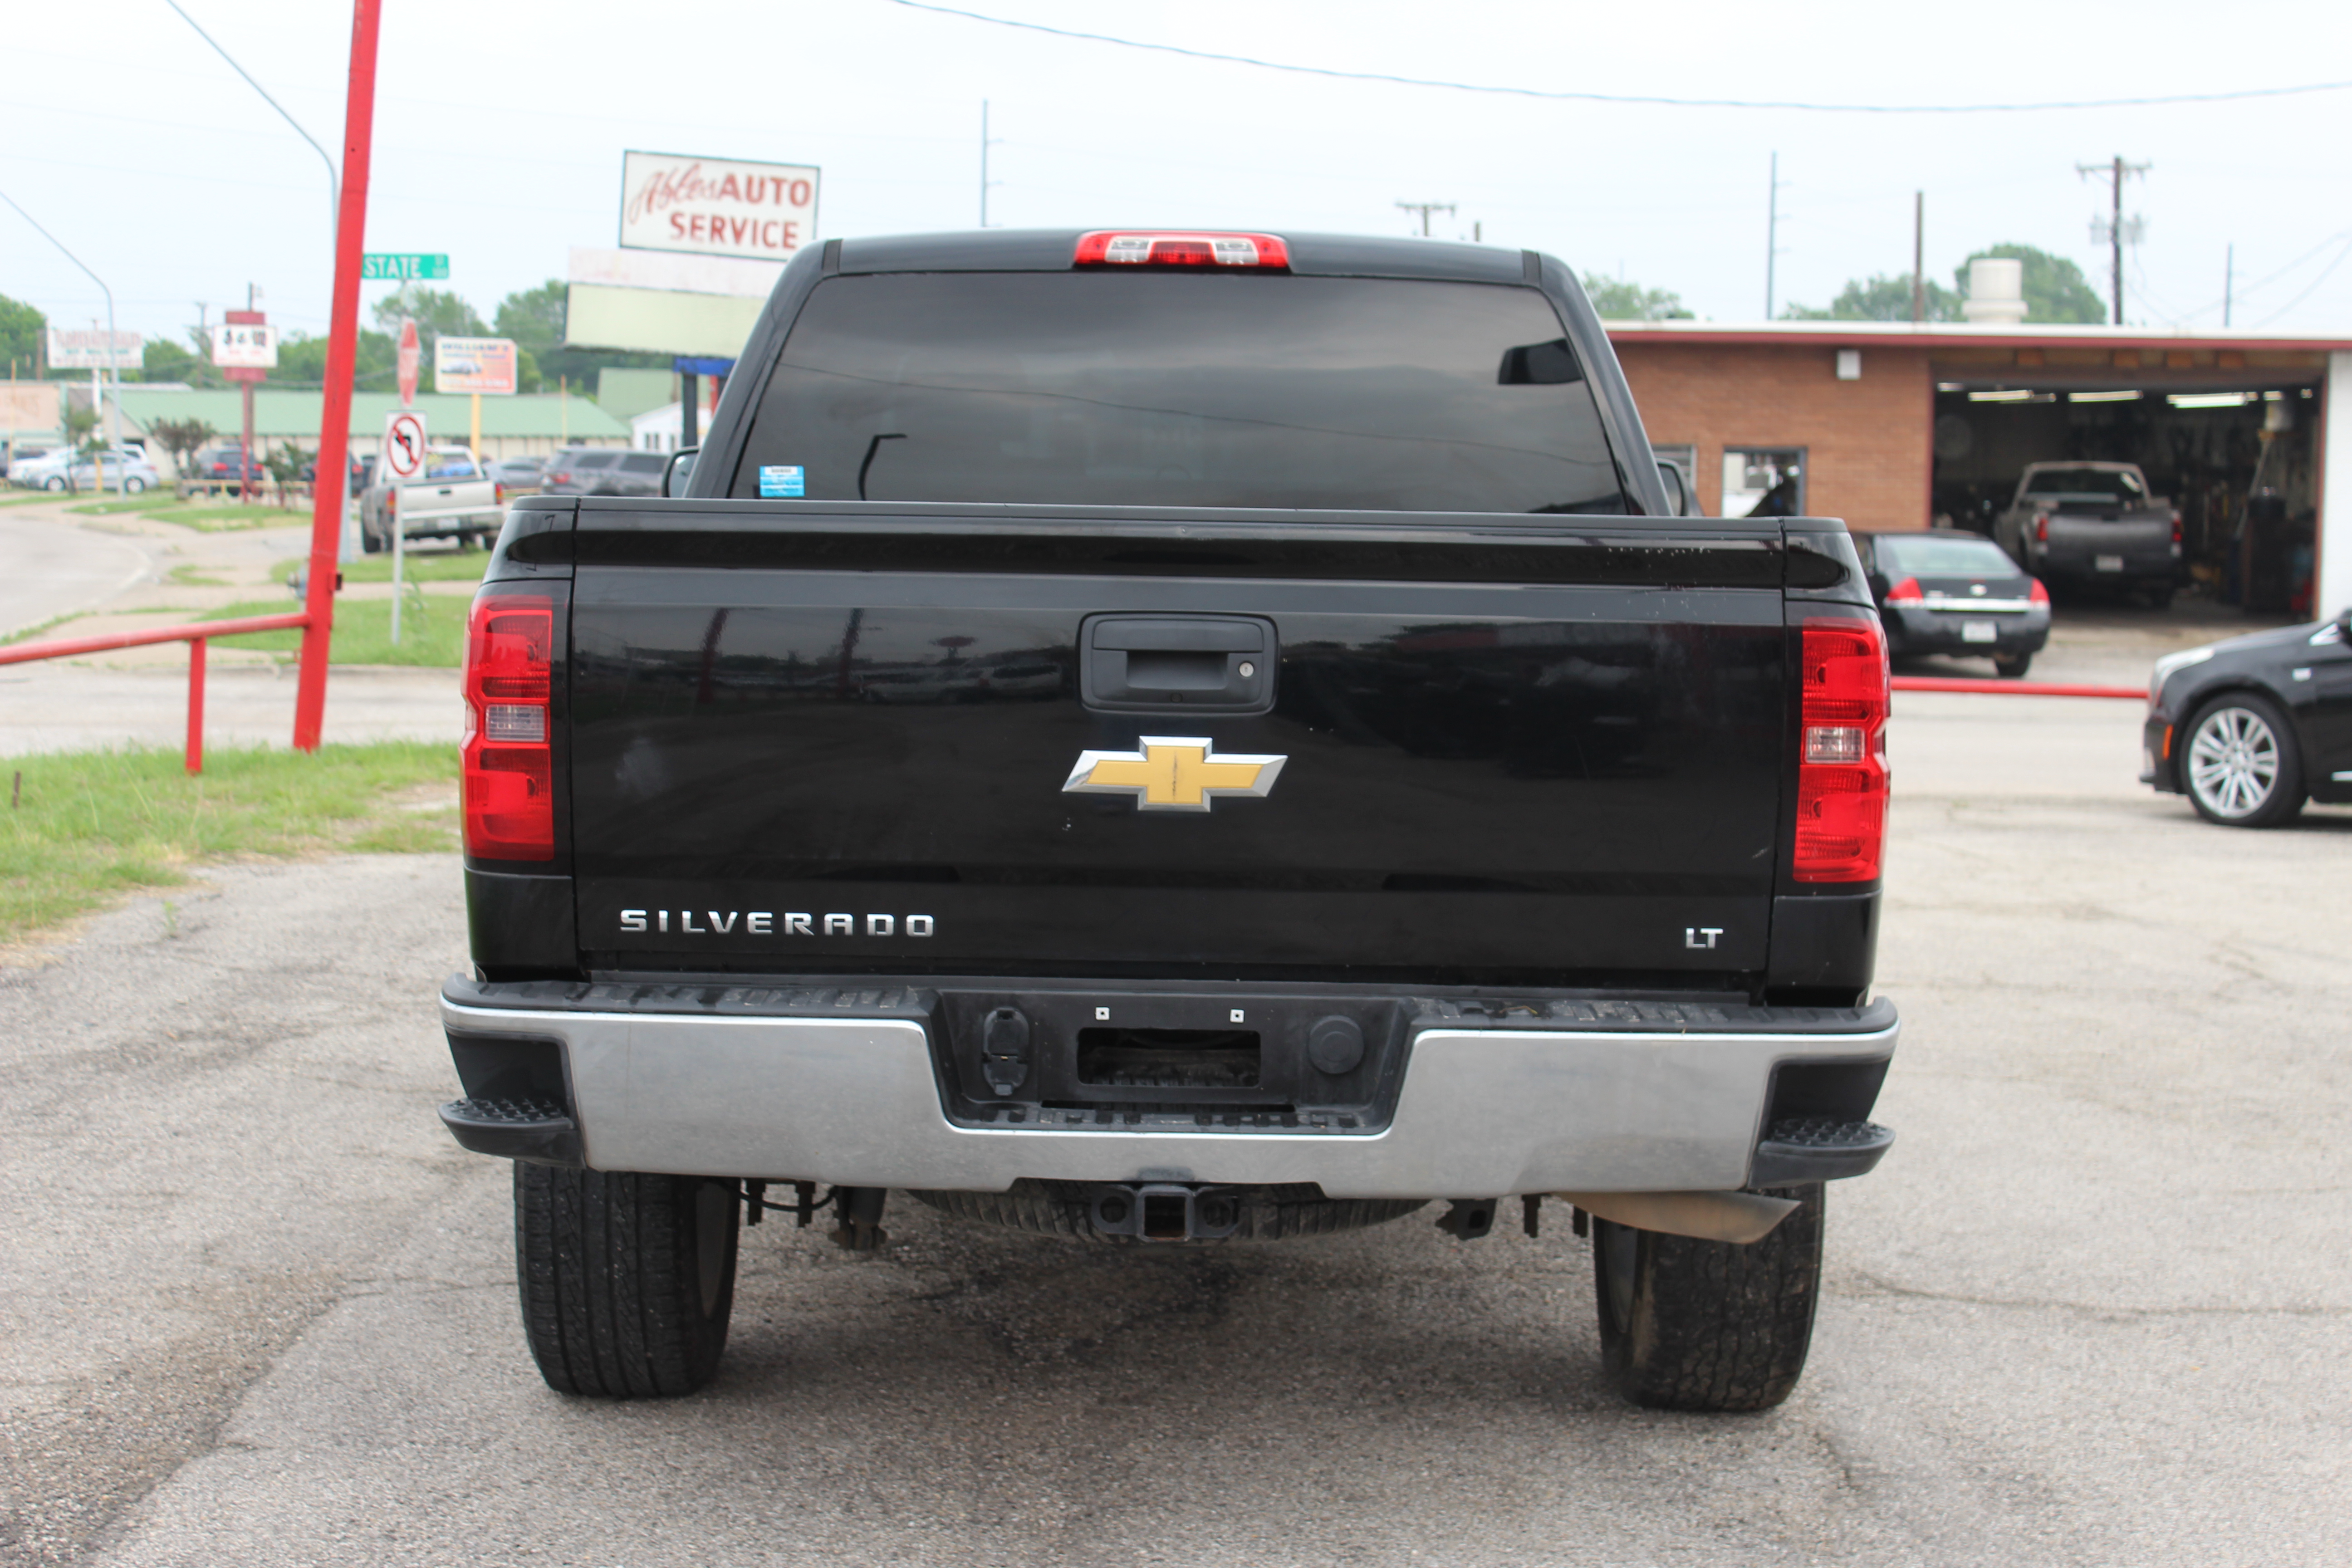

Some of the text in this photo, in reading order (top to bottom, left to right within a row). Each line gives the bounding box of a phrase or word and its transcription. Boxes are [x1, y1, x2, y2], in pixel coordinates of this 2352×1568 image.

[719, 172, 812, 207] AUTO
[669, 211, 800, 250] SERVICE
[364, 256, 422, 278] STATE
[620, 909, 935, 938] SILVERADO
[1686, 928, 1724, 949] LT
